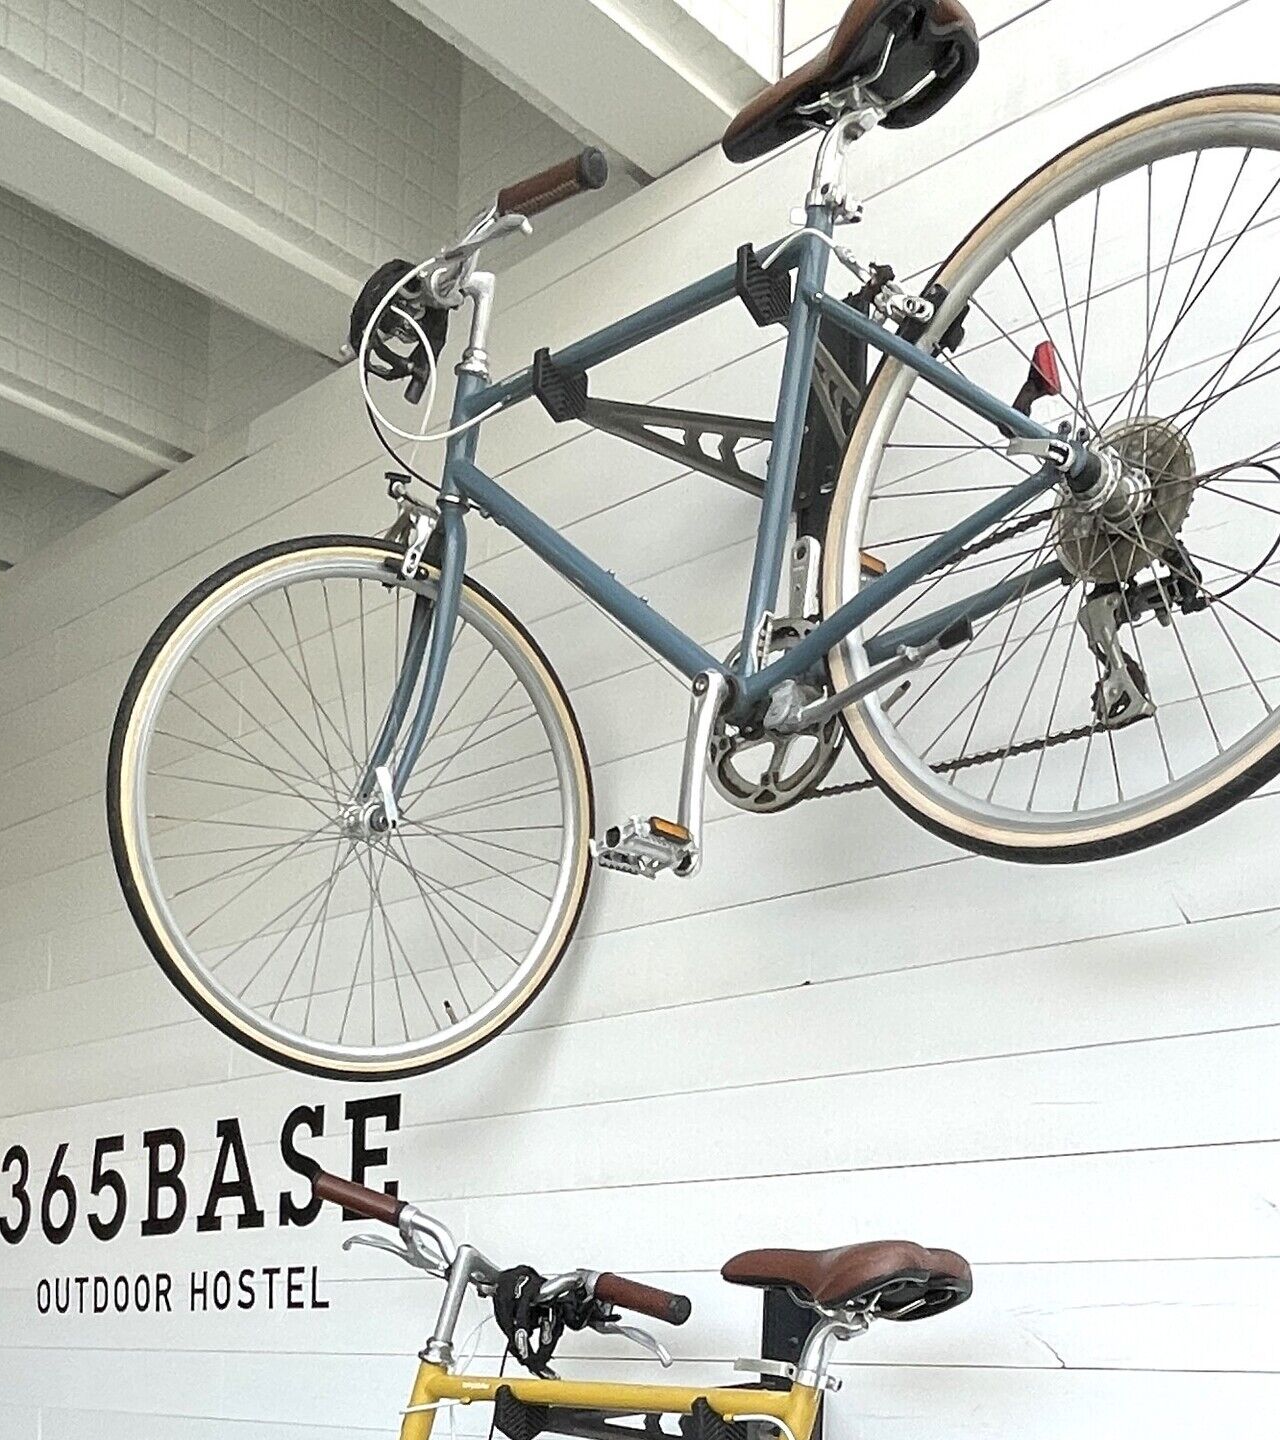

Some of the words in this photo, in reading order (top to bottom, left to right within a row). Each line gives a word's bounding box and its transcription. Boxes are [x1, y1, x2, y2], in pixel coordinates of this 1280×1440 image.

[0, 1094, 401, 1244] 365BASE
[37, 1273, 172, 1314] OUTDOOR
[190, 1266, 330, 1311] HOSTEL
